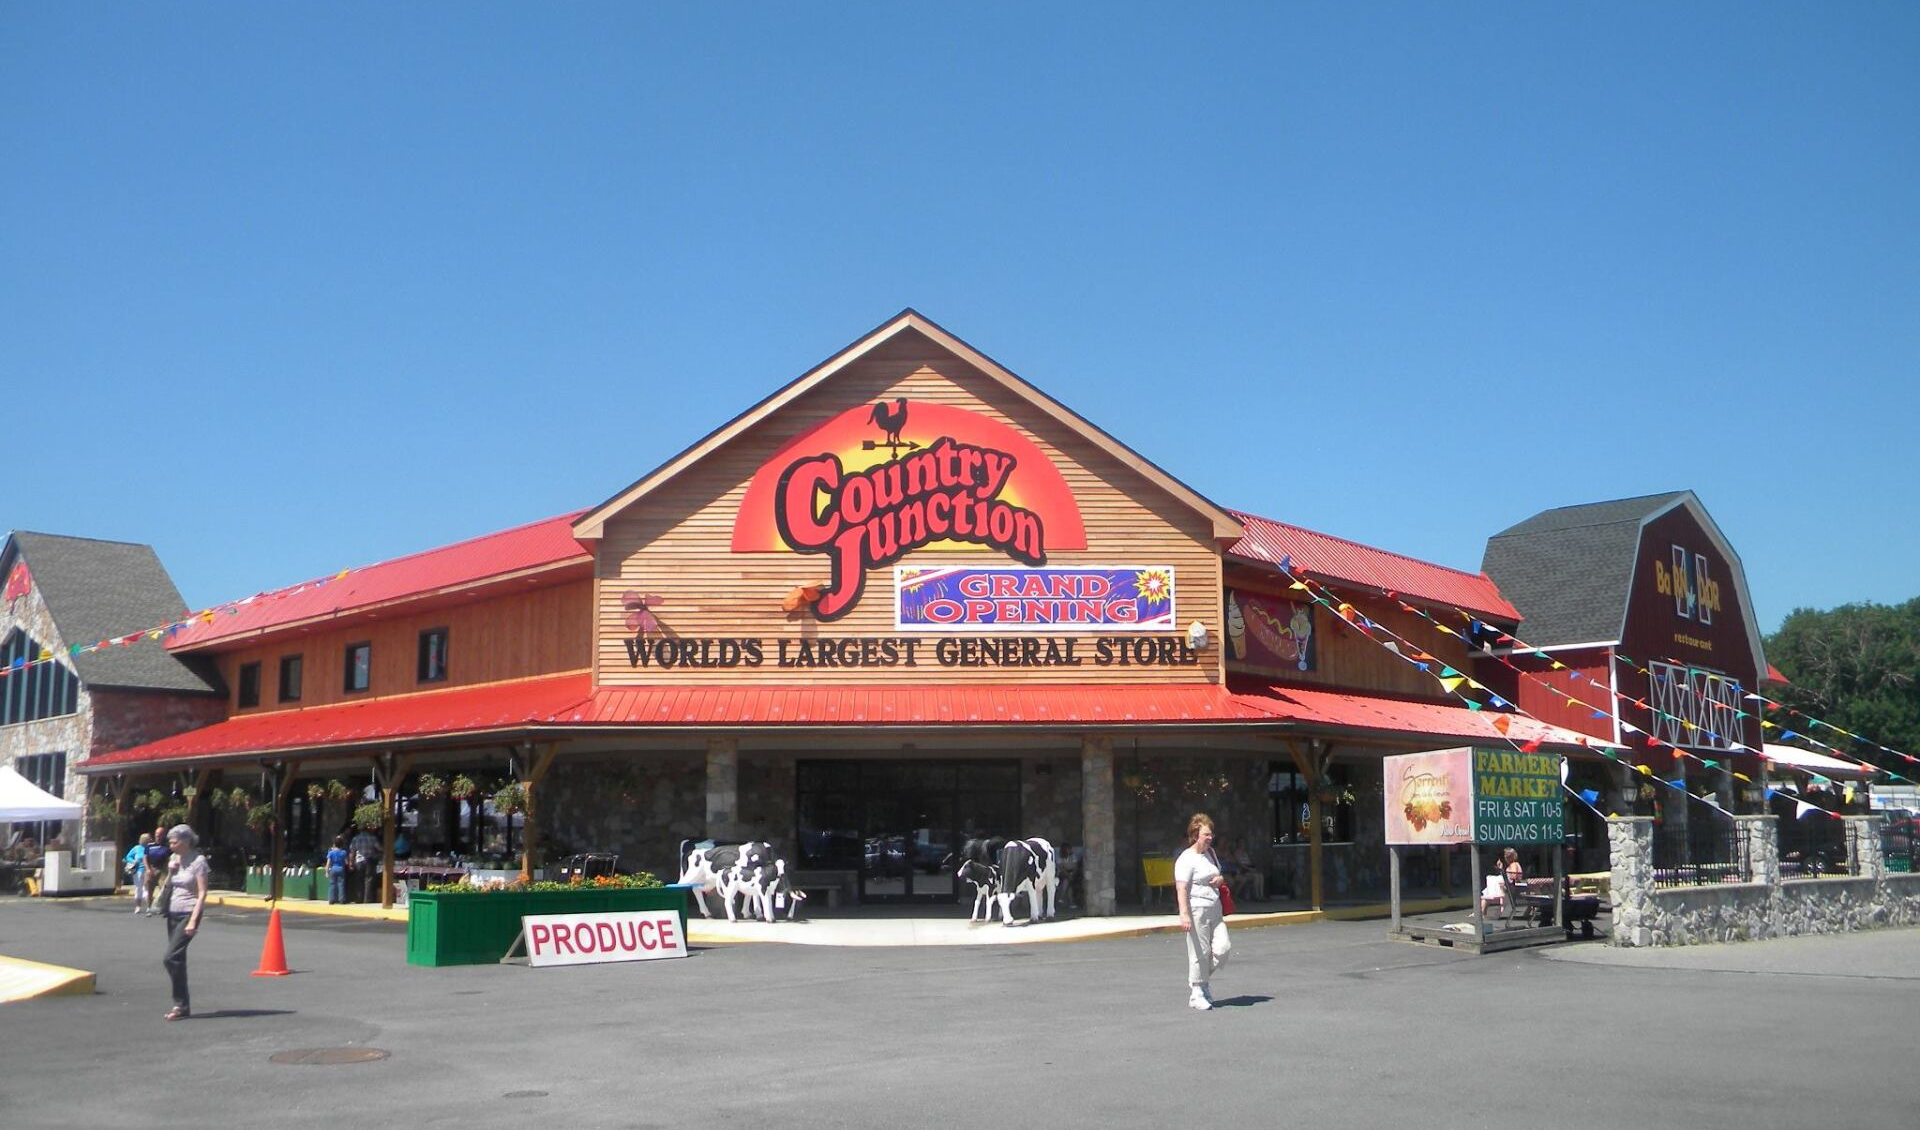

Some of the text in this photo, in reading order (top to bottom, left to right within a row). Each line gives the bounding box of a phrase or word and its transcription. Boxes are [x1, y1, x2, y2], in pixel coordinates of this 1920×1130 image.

[778, 437, 1016, 550] Country
[813, 488, 1045, 619] Junction
[958, 574, 1111, 598] GRAND
[923, 599, 1139, 623] OPENING
[624, 638, 764, 669] WORLD'S
[777, 637, 922, 668] LARGEST
[936, 637, 1082, 667] GENERAL
[1477, 752, 1560, 776] FARMERS
[1480, 776, 1558, 798] MARKET
[1479, 801, 1562, 818] FRI & SAT 10-5
[1479, 824, 1563, 841] SUNDAYS 11-5
[531, 919, 677, 956] PRODUCE
